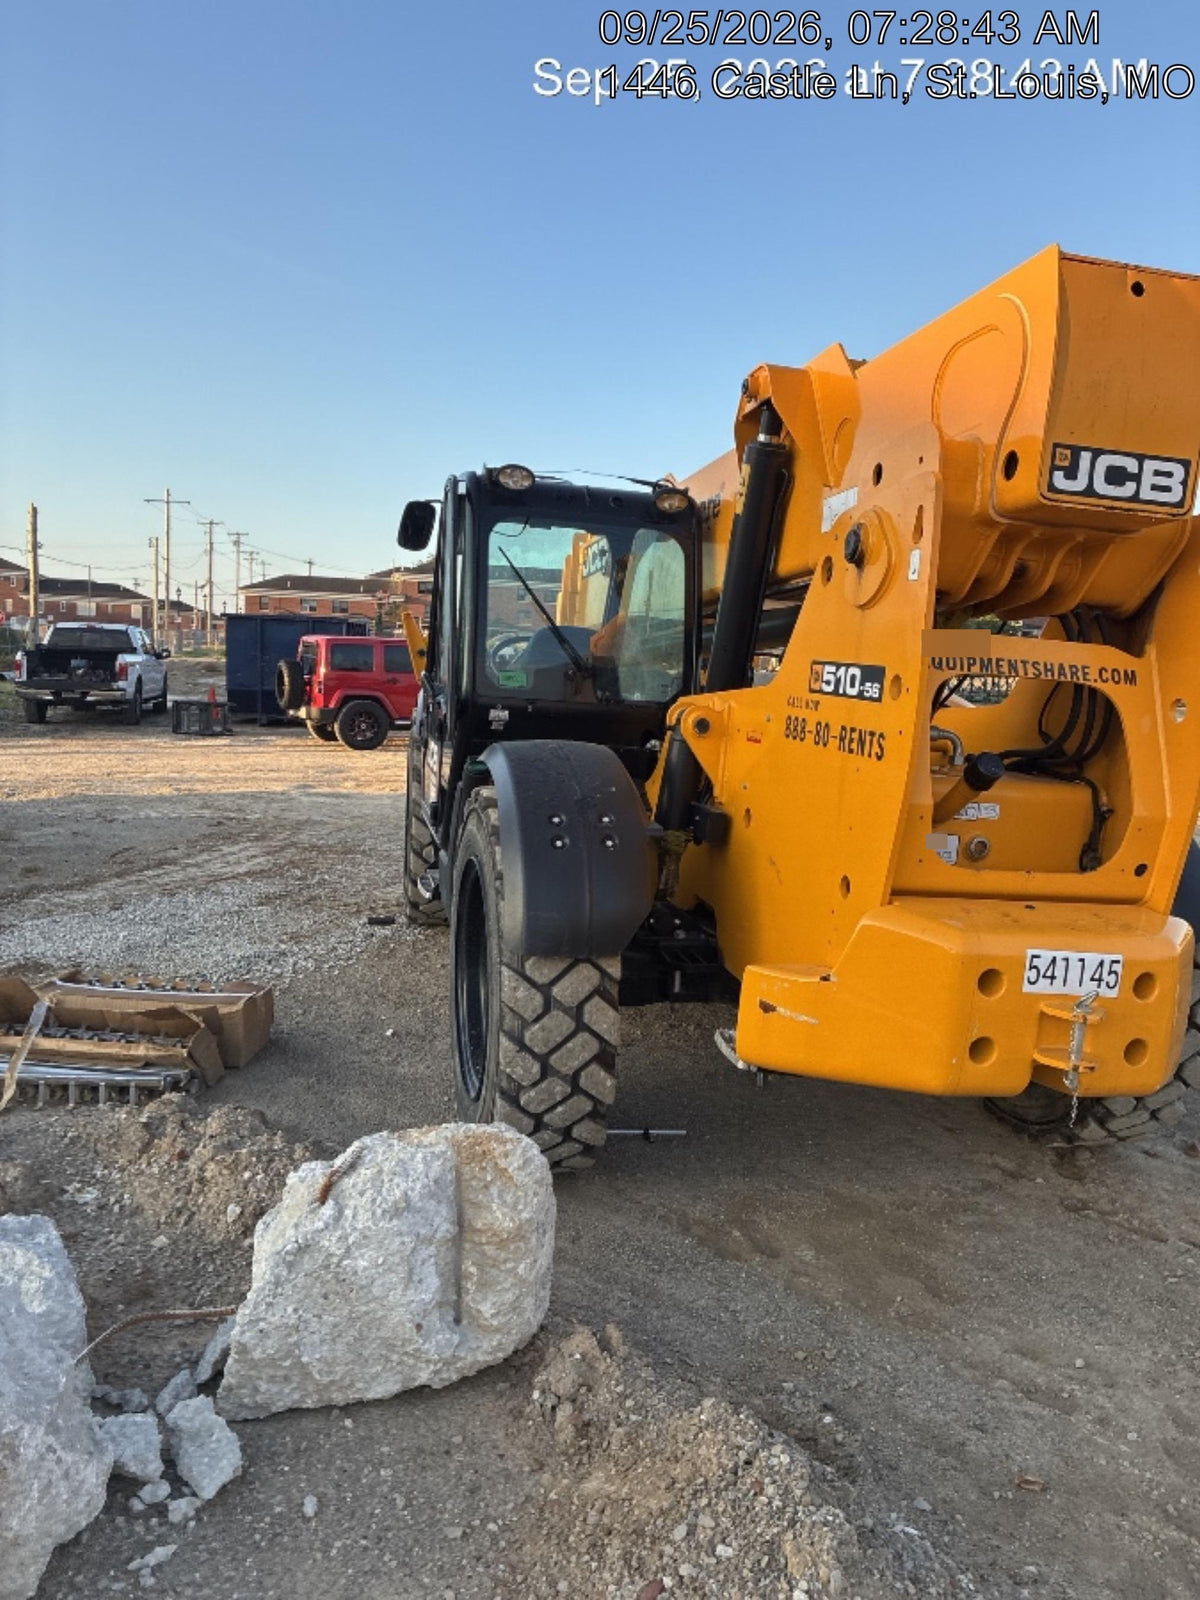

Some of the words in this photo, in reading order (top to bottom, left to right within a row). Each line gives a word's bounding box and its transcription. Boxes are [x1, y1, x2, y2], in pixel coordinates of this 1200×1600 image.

[1052, 451, 1185, 503] JCB
[927, 656, 1138, 687] QUIPMENTSHARE.COM
[785, 715, 886, 761] 888-80-RENTS
[1026, 954, 1121, 990] 541145
